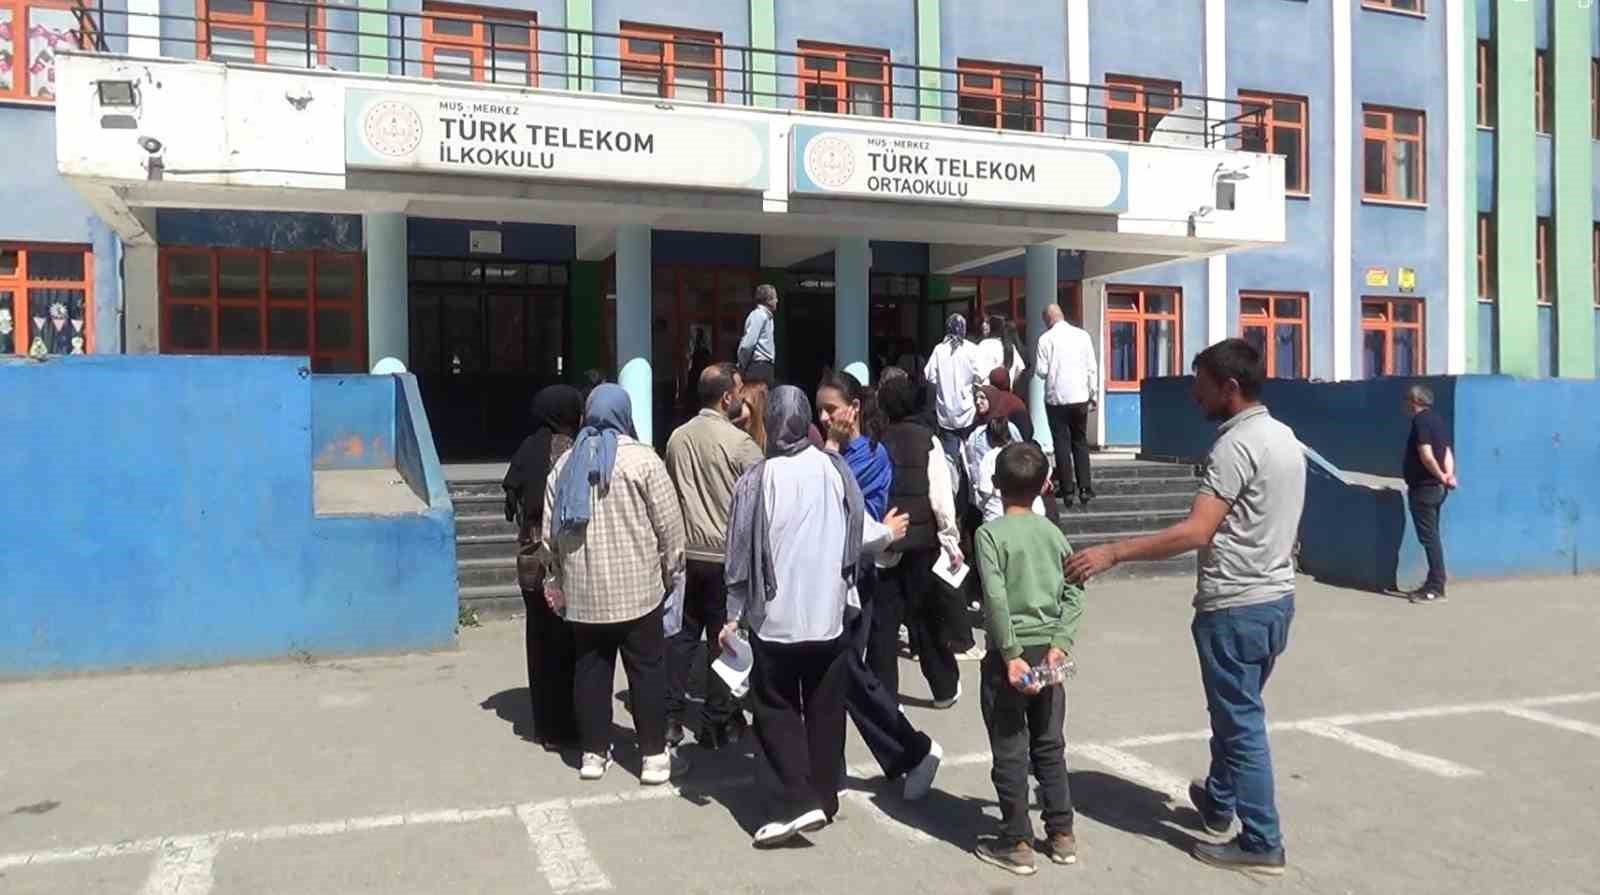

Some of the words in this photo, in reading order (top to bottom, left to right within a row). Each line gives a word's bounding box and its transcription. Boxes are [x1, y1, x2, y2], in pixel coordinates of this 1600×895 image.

[473, 103, 520, 116] MERKEZ
[440, 113, 518, 144] TÜRK
[526, 124, 654, 154] TELEKOM
[894, 140, 930, 151] MERKEZ
[440, 141, 555, 169] İLKOKULU
[867, 148, 929, 175] TÜRK
[935, 157, 1036, 183] TELEKOM
[867, 176, 968, 197] ORTAOKULU
